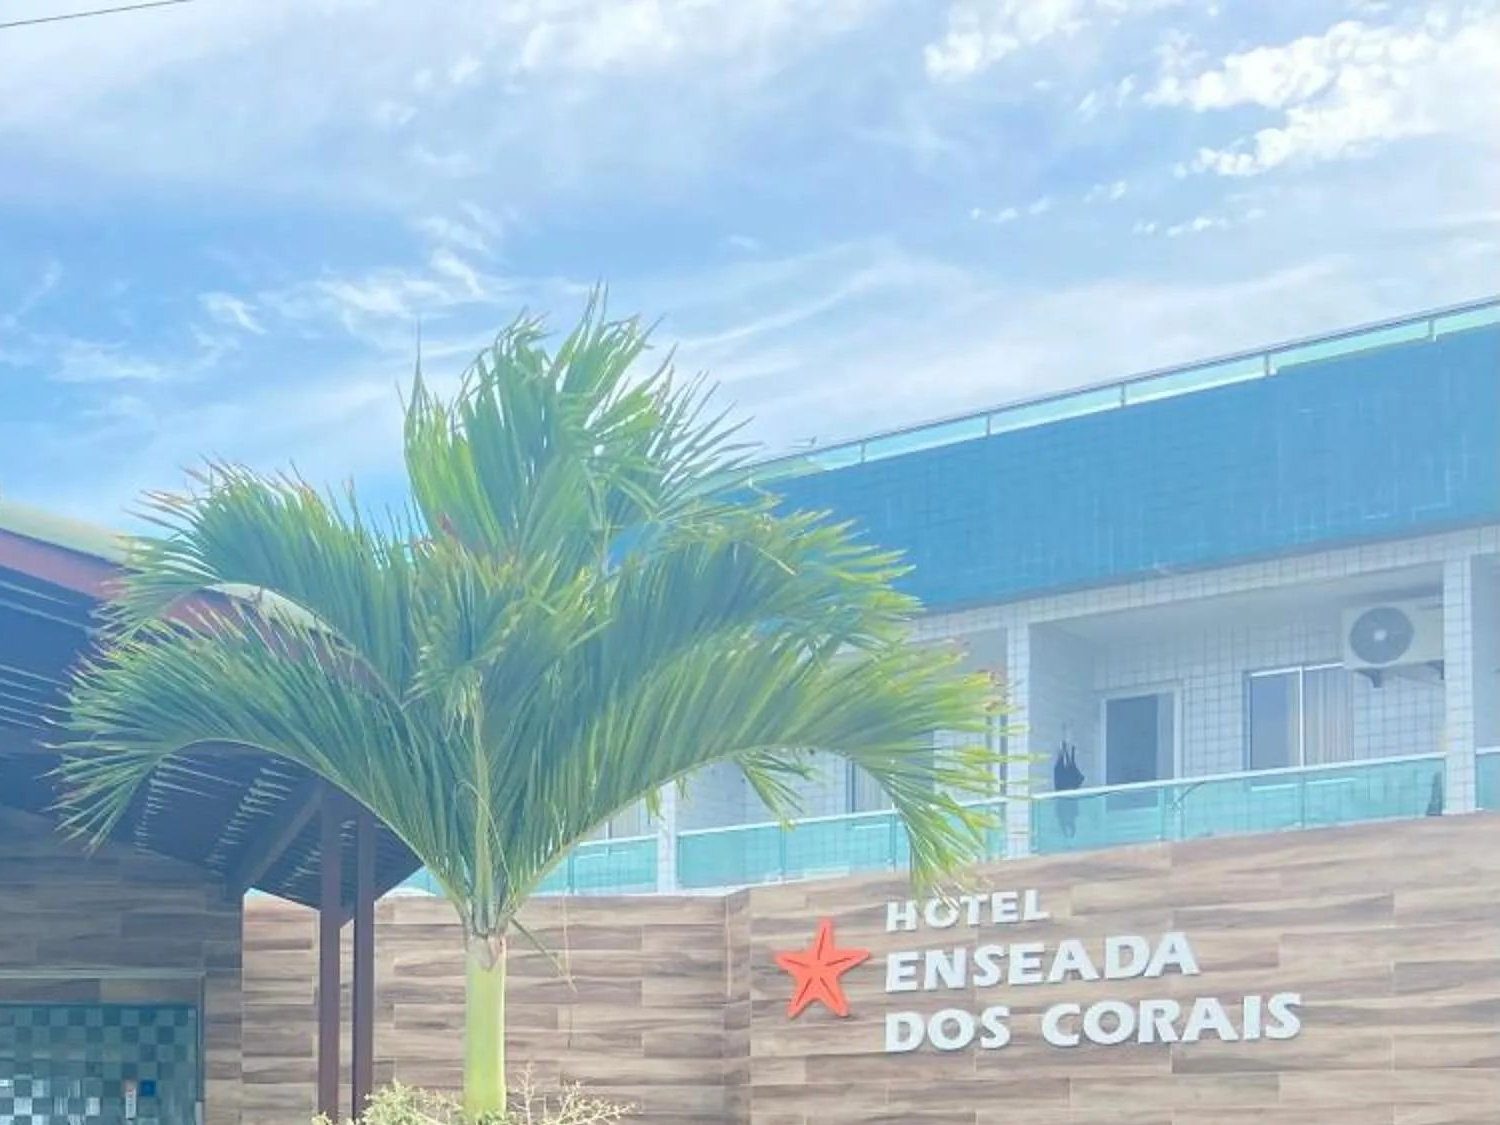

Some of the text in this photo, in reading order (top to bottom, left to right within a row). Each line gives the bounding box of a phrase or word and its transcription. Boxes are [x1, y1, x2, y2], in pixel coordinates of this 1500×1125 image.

[886, 889, 1050, 932] HOTEL
[885, 931, 1200, 993] ENSEADA
[884, 992, 1302, 1052] DOS CORAIS
